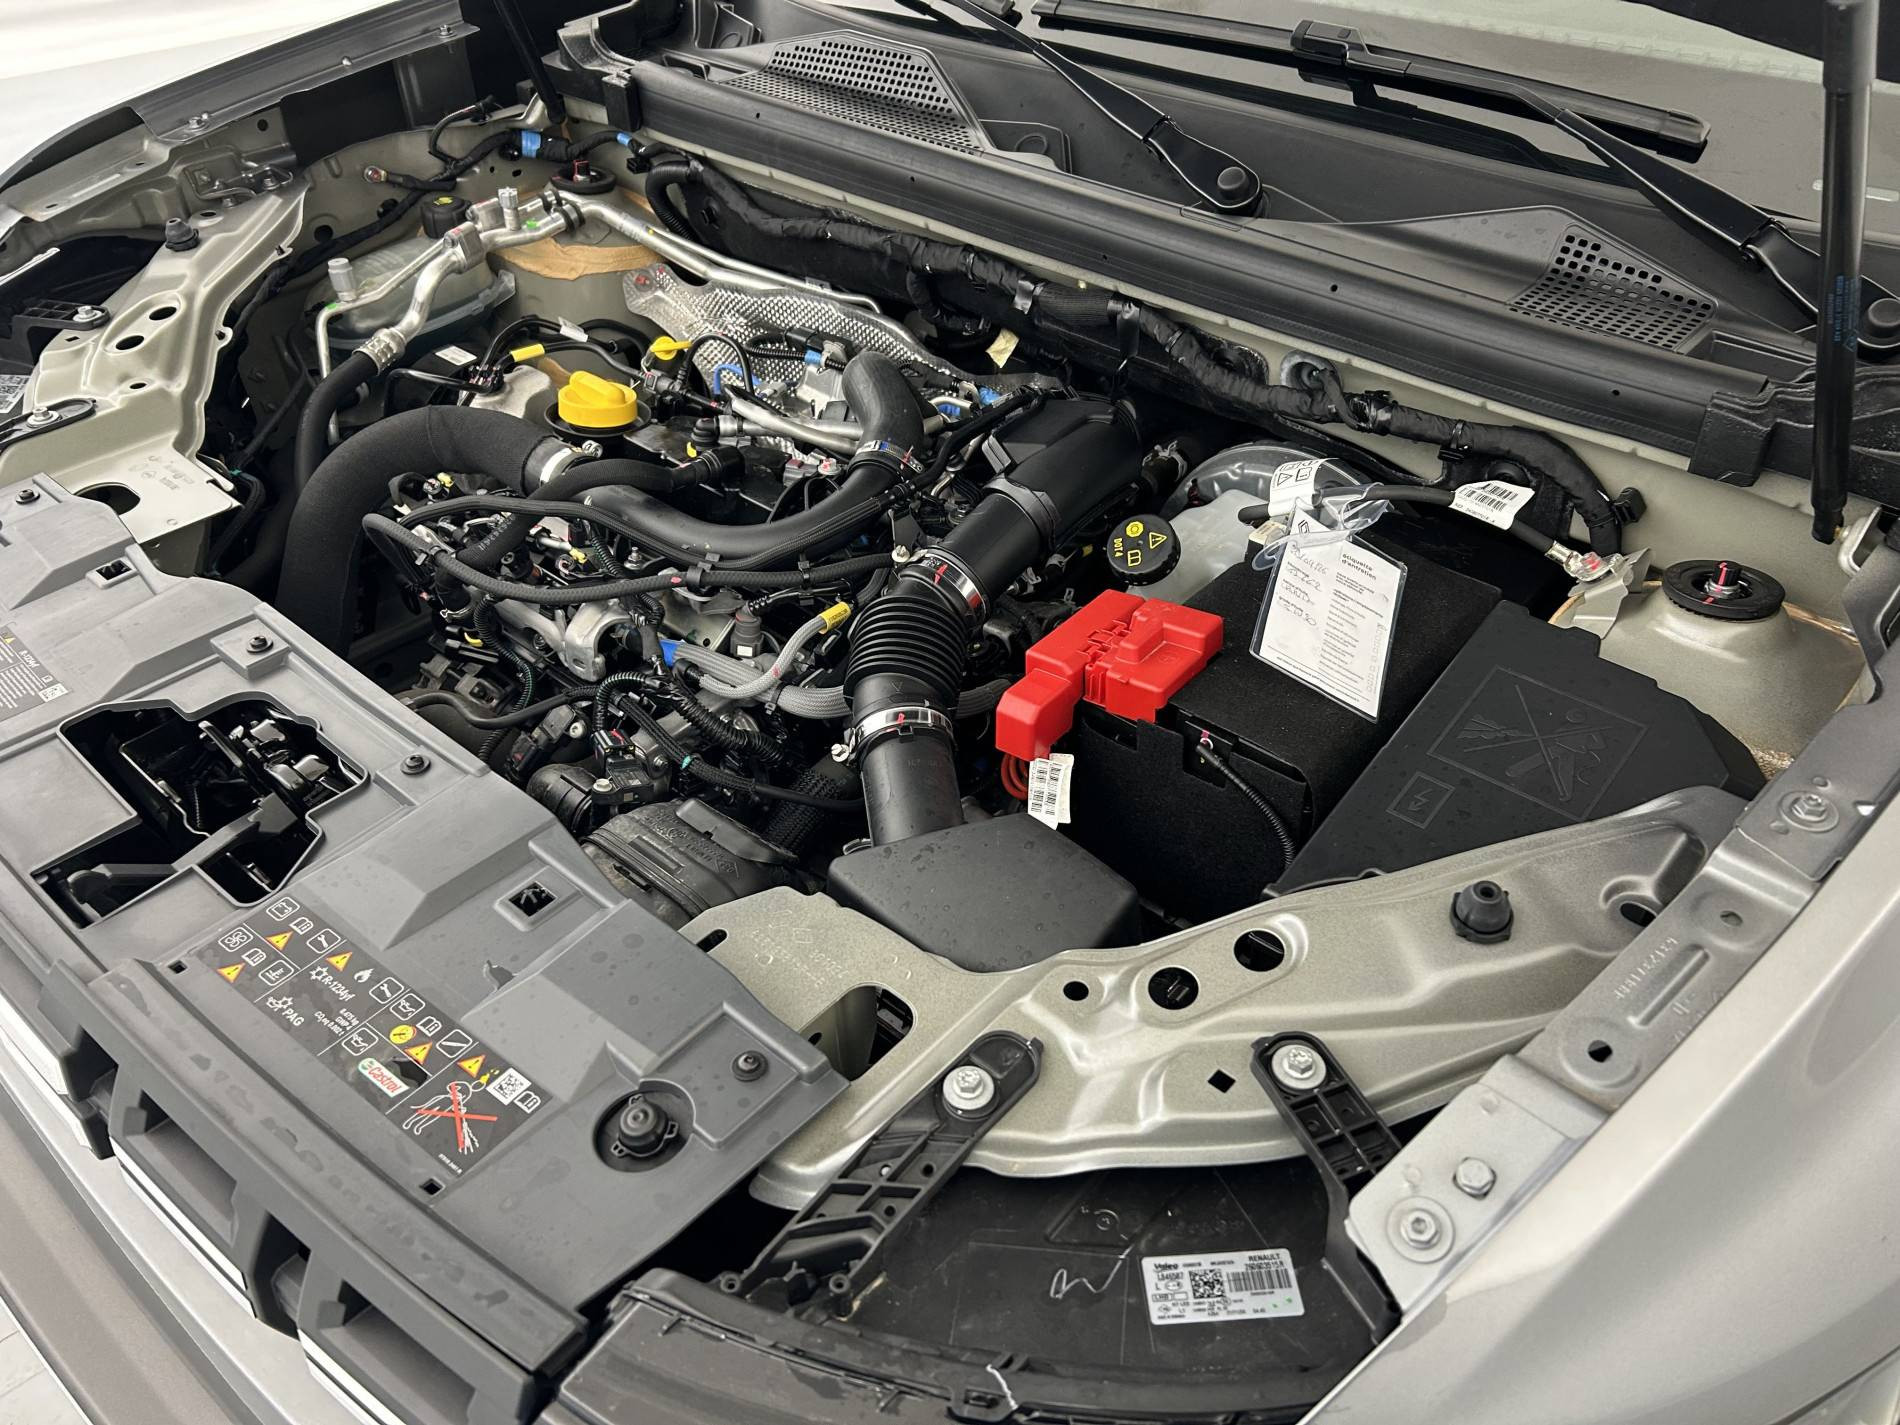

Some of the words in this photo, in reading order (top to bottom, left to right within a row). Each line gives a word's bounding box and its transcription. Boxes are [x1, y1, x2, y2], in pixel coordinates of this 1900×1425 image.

[1113, 537, 1124, 551] DOT
[321, 975, 356, 1002] R-1234yf
[282, 1008, 305, 1026] PAG
[367, 1066, 402, 1093] Castrol
[1248, 1253, 1281, 1262] RENAULT
[1154, 1263, 1179, 1272] Valeo
